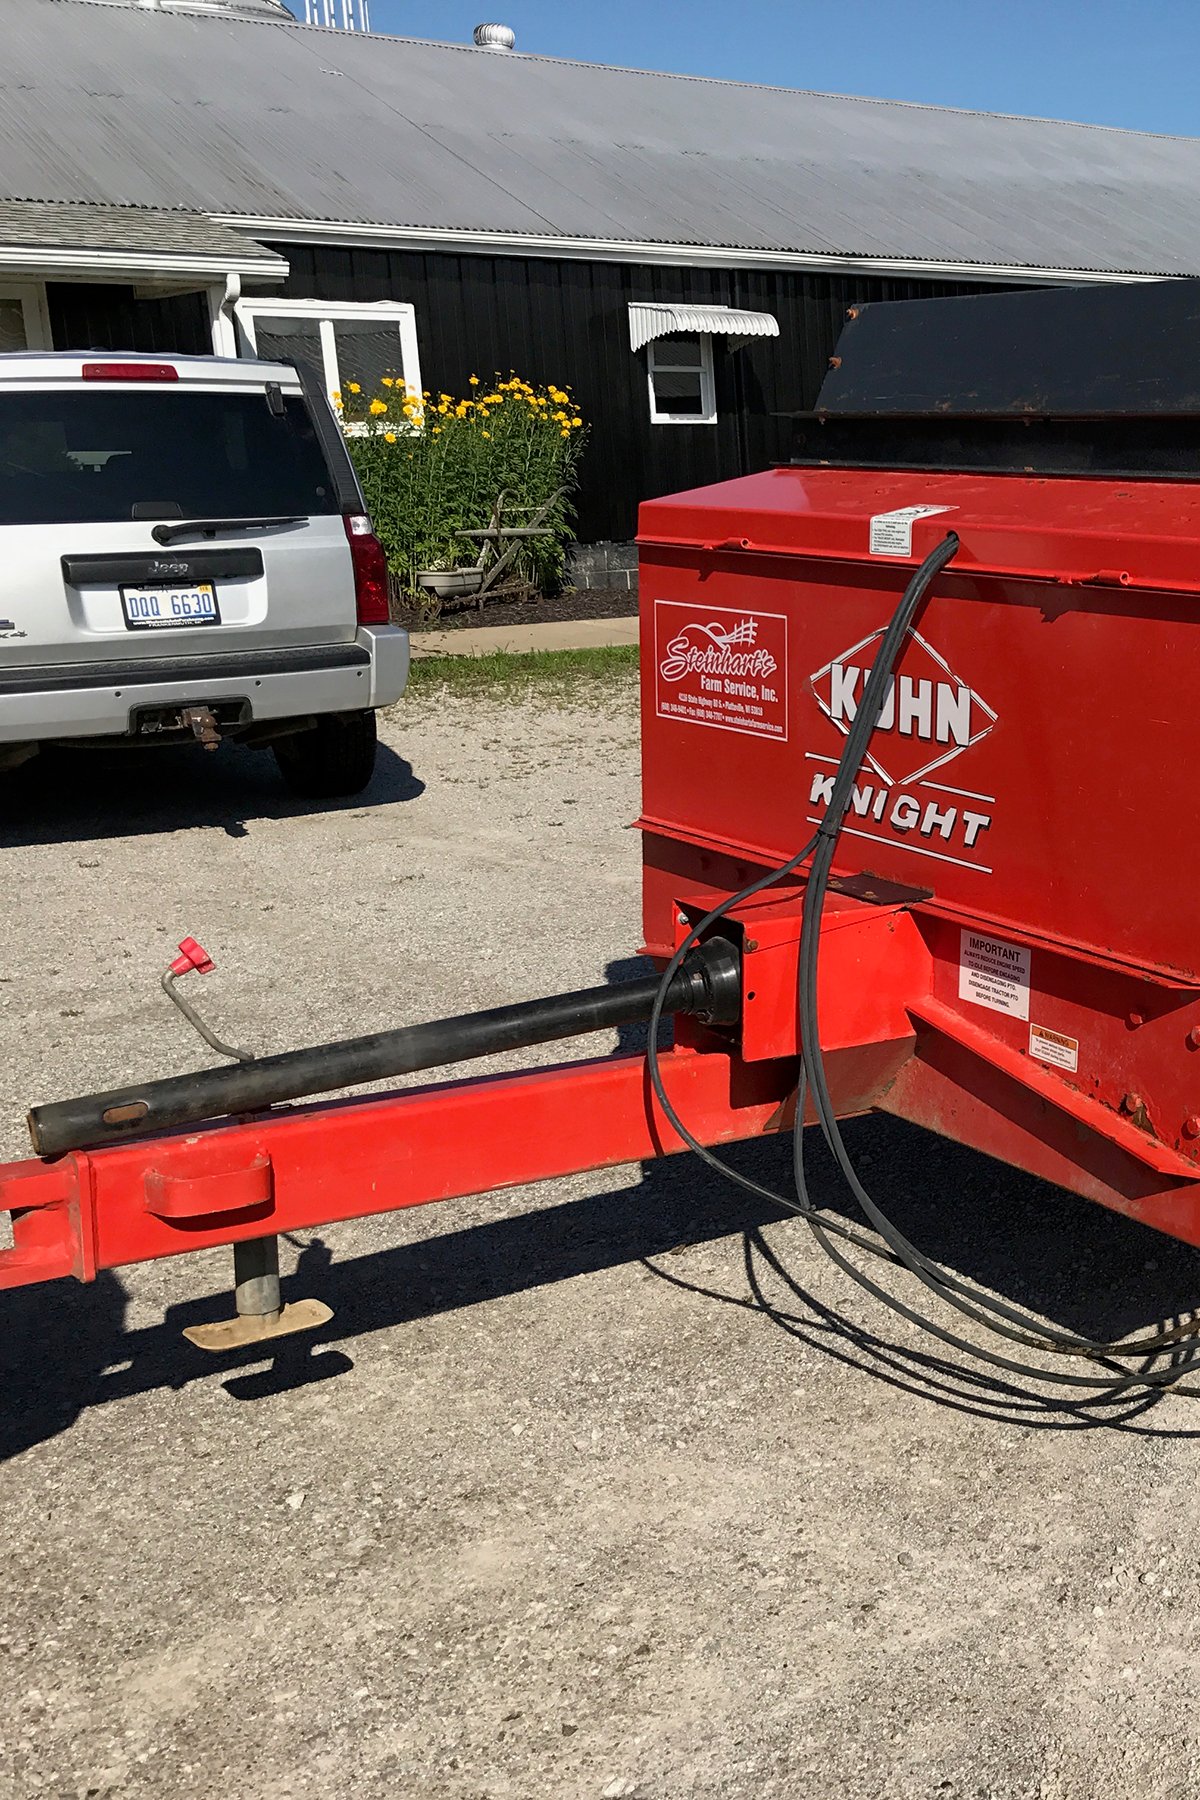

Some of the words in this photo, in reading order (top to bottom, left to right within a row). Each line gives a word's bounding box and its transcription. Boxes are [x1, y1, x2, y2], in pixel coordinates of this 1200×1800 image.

[148, 561, 189, 576] Jeep
[128, 596, 161, 618] DQQ
[171, 593, 212, 615] 6630
[660, 637, 777, 682] Steinhart's
[701, 674, 722, 693] Farm
[724, 678, 759, 701] Service,
[761, 684, 779, 703] Inc.
[830, 662, 972, 747] KUHN
[809, 773, 991, 846] KNIGHT
[969, 937, 1021, 962] IMPORTANT
